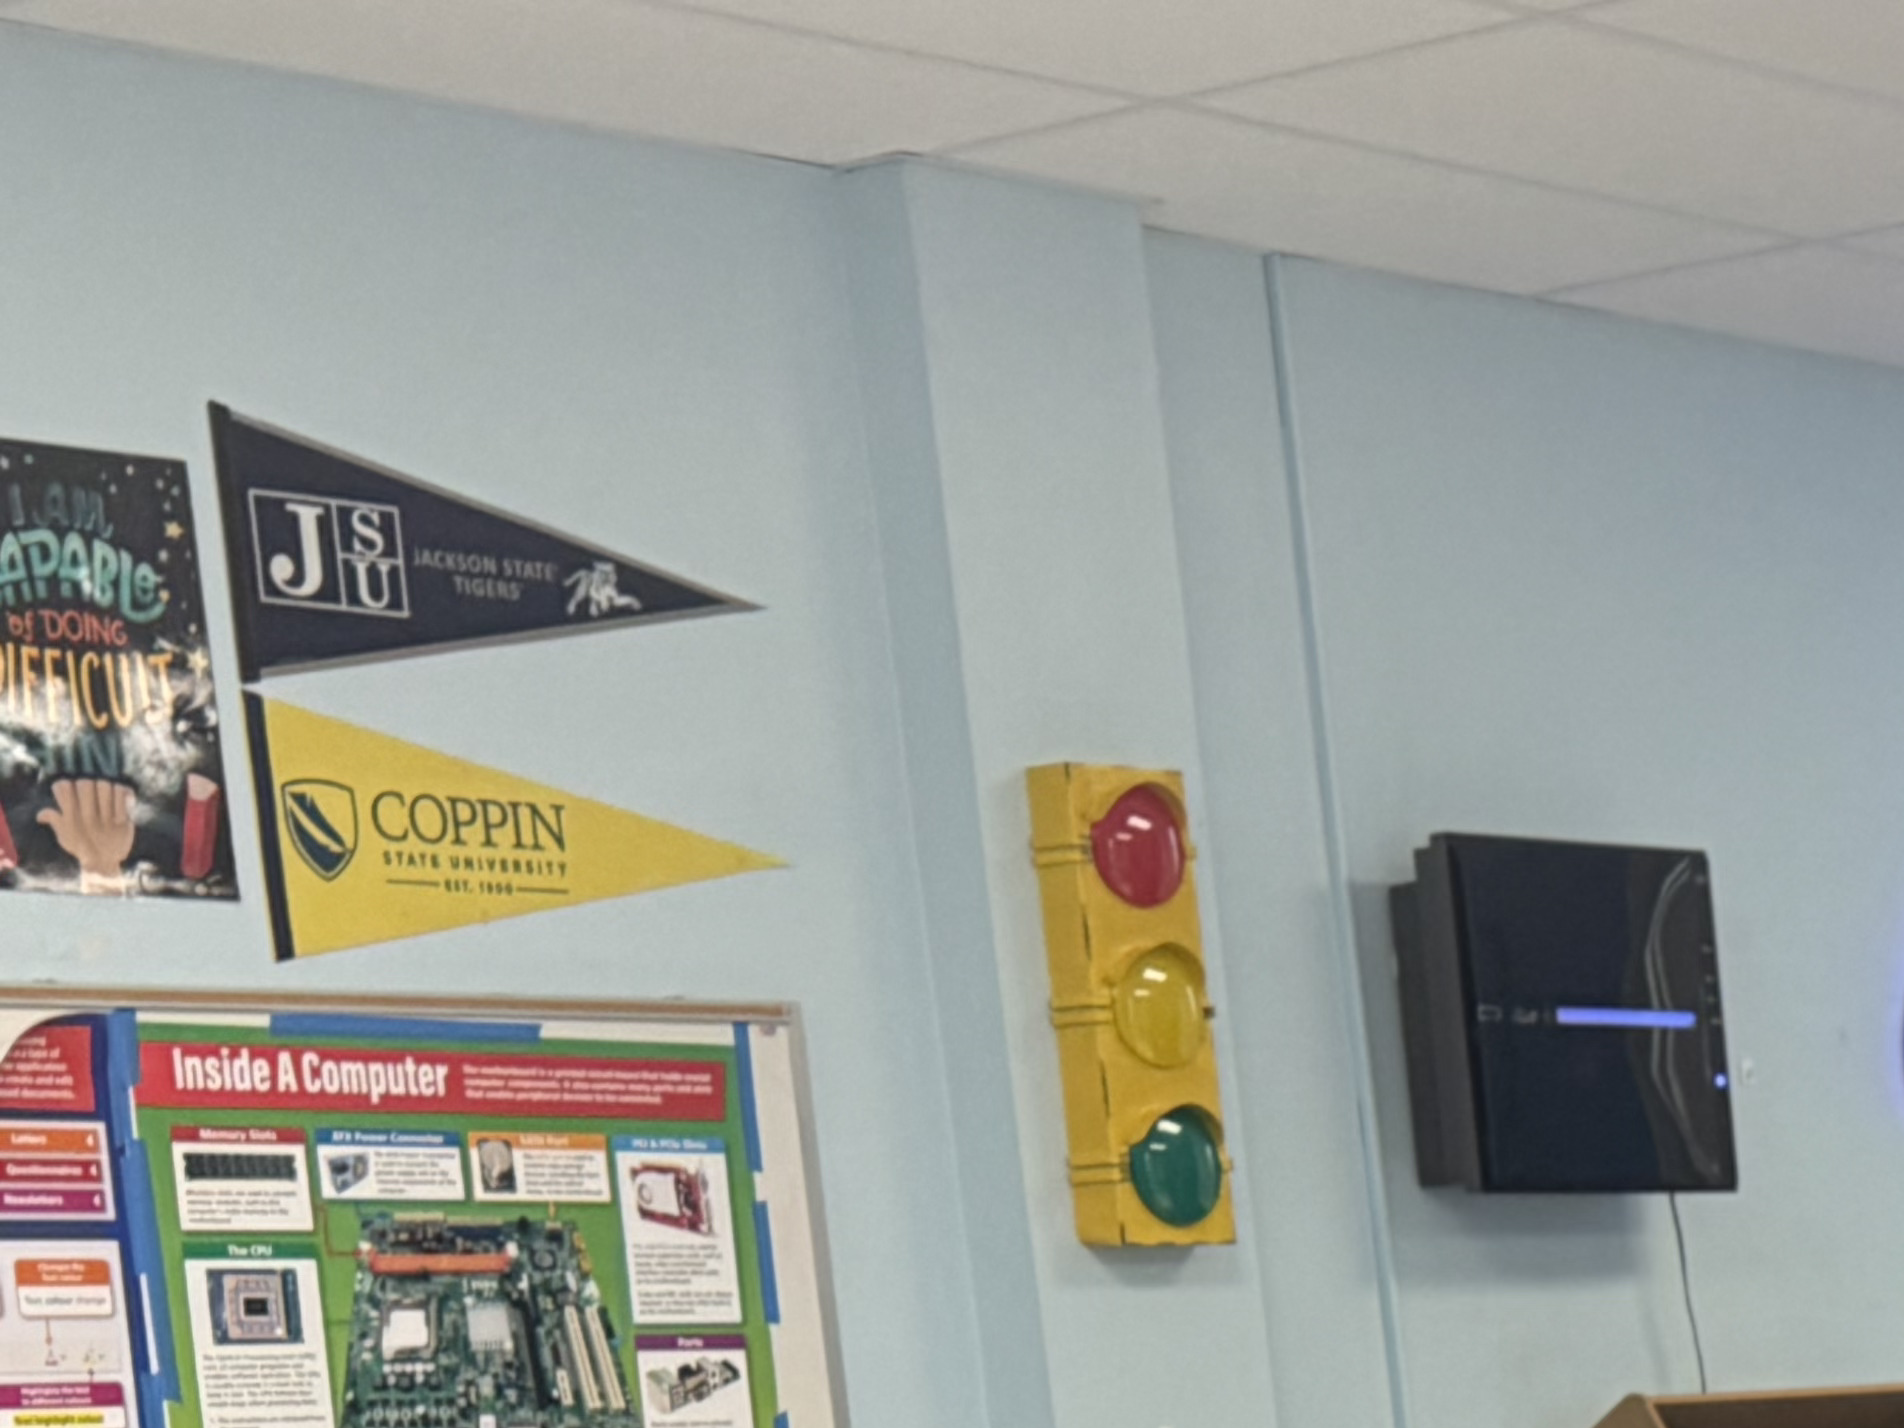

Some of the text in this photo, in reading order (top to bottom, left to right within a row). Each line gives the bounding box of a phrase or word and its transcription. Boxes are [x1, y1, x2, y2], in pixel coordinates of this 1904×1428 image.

[414, 546, 553, 582] JACKSON STATE
[453, 575, 520, 600] TIGERS
[38, 609, 128, 645] DOING
[0, 641, 173, 730] IFFICULT
[371, 790, 566, 852] COPPIN
[383, 850, 567, 878] STATE UNIVERSITY
[172, 1047, 271, 1092] Inside
[278, 1051, 298, 1093] A
[302, 1052, 448, 1105] Computer
